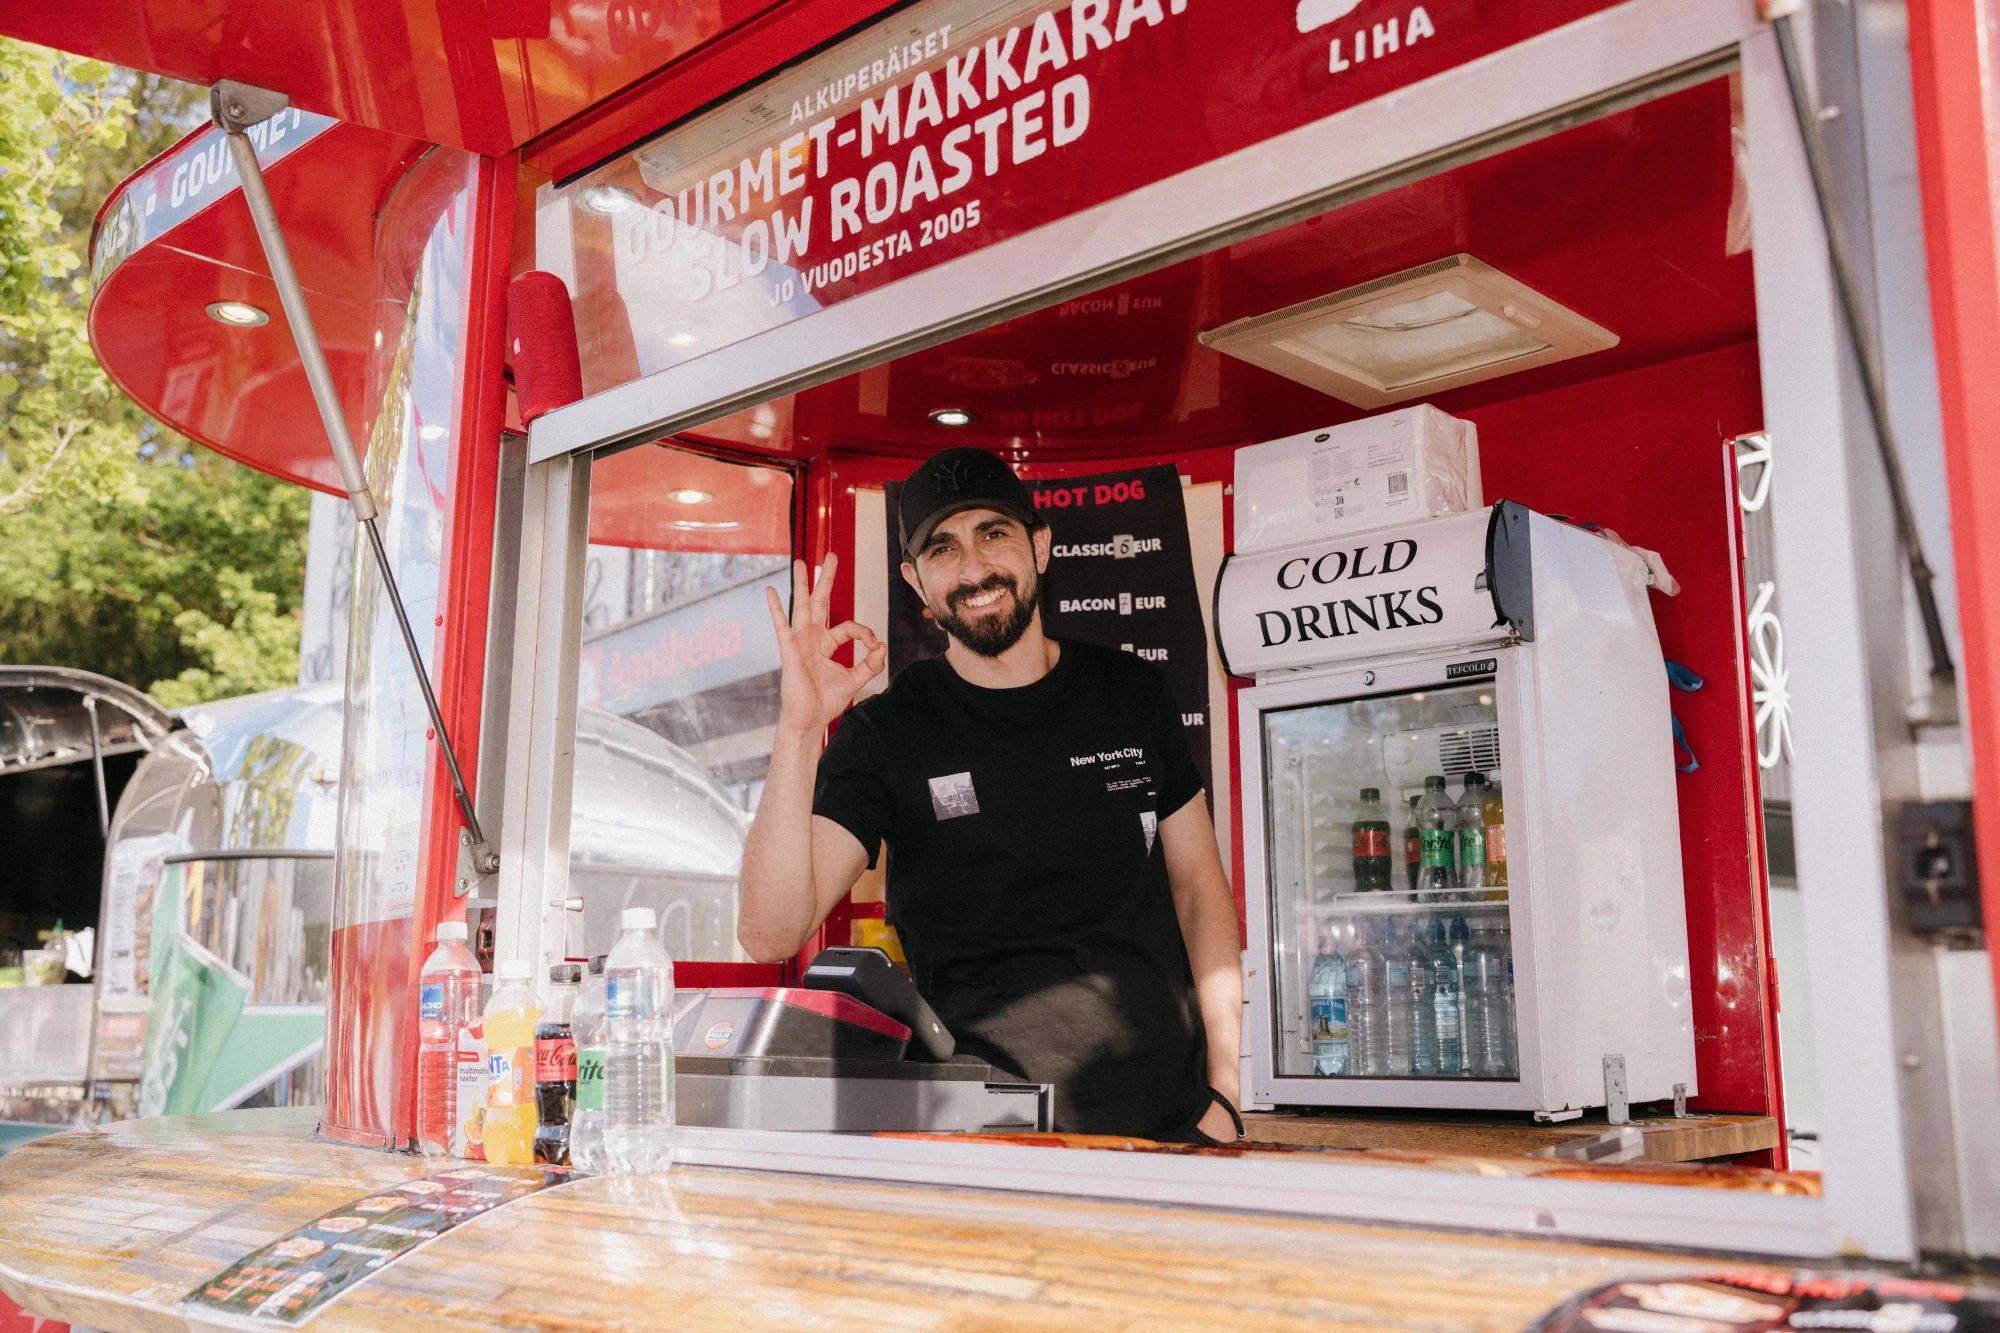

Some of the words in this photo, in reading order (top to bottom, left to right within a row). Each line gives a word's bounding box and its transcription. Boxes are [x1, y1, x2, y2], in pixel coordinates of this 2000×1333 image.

[1329, 6, 1434, 73] LIHA
[790, 25, 951, 125] ALKUPERÄISET
[622, 0, 1188, 267] GOURMET-MAKKARA
[690, 196, 813, 301] SLOW
[830, 74, 1090, 242] ROASTED
[770, 279, 794, 307] JO
[800, 230, 913, 293] VUODESTA
[919, 200, 980, 247] 2005
[1033, 487, 1087, 509] HOT
[1095, 480, 1145, 504] DOG
[1053, 543, 1115, 557] CLASSIC
[1133, 538, 1162, 553] EUR
[1276, 539, 1418, 590] COLD
[1060, 599, 1115, 612] BACON
[1135, 596, 1166, 609] EUR
[1255, 586, 1444, 647] DRINKS
[1137, 648, 1168, 661] EUR
[1448, 663, 1486, 675] TEFCOLD
[1182, 713, 1204, 726] UR
[1070, 754, 1096, 766] New
[1097, 749, 1123, 762] York
[1123, 748, 1143, 758] City
